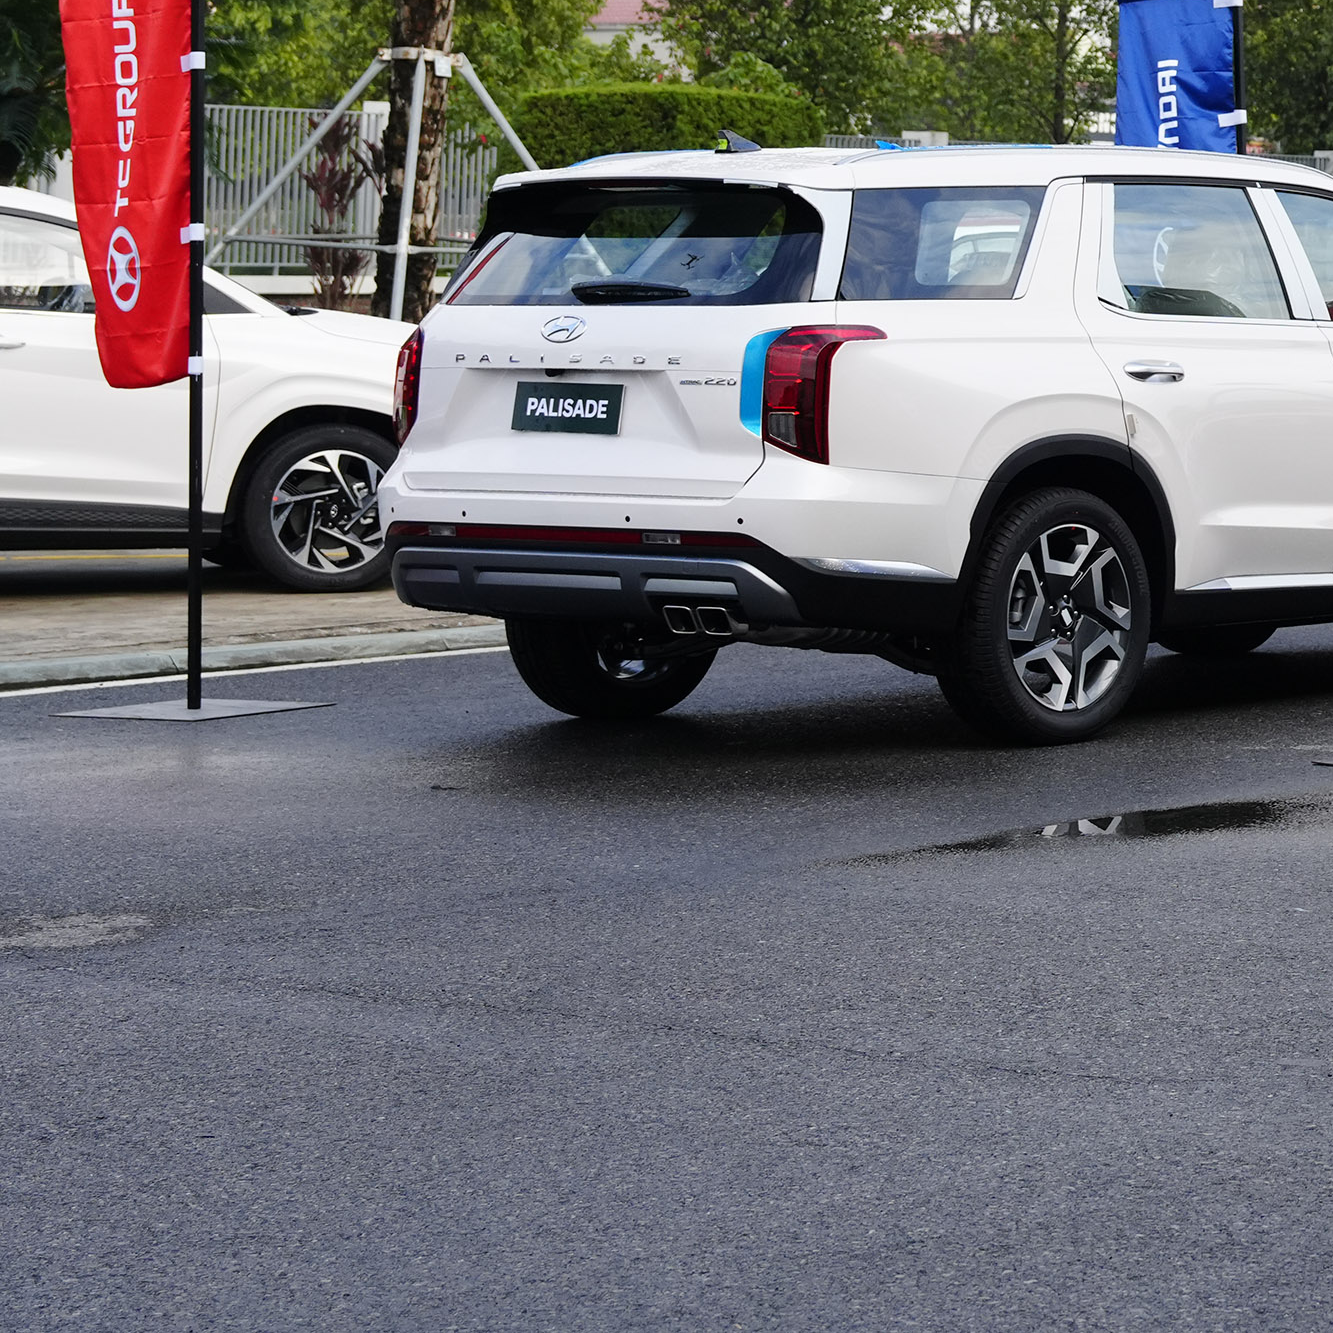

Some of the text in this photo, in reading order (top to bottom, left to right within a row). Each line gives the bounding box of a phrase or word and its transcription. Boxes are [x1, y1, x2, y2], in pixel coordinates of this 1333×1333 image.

[1157, 59, 1180, 149] NDAI
[113, 158, 131, 218] TC
[455, 353, 682, 365] PALISADE
[526, 397, 609, 419] PALISADE
